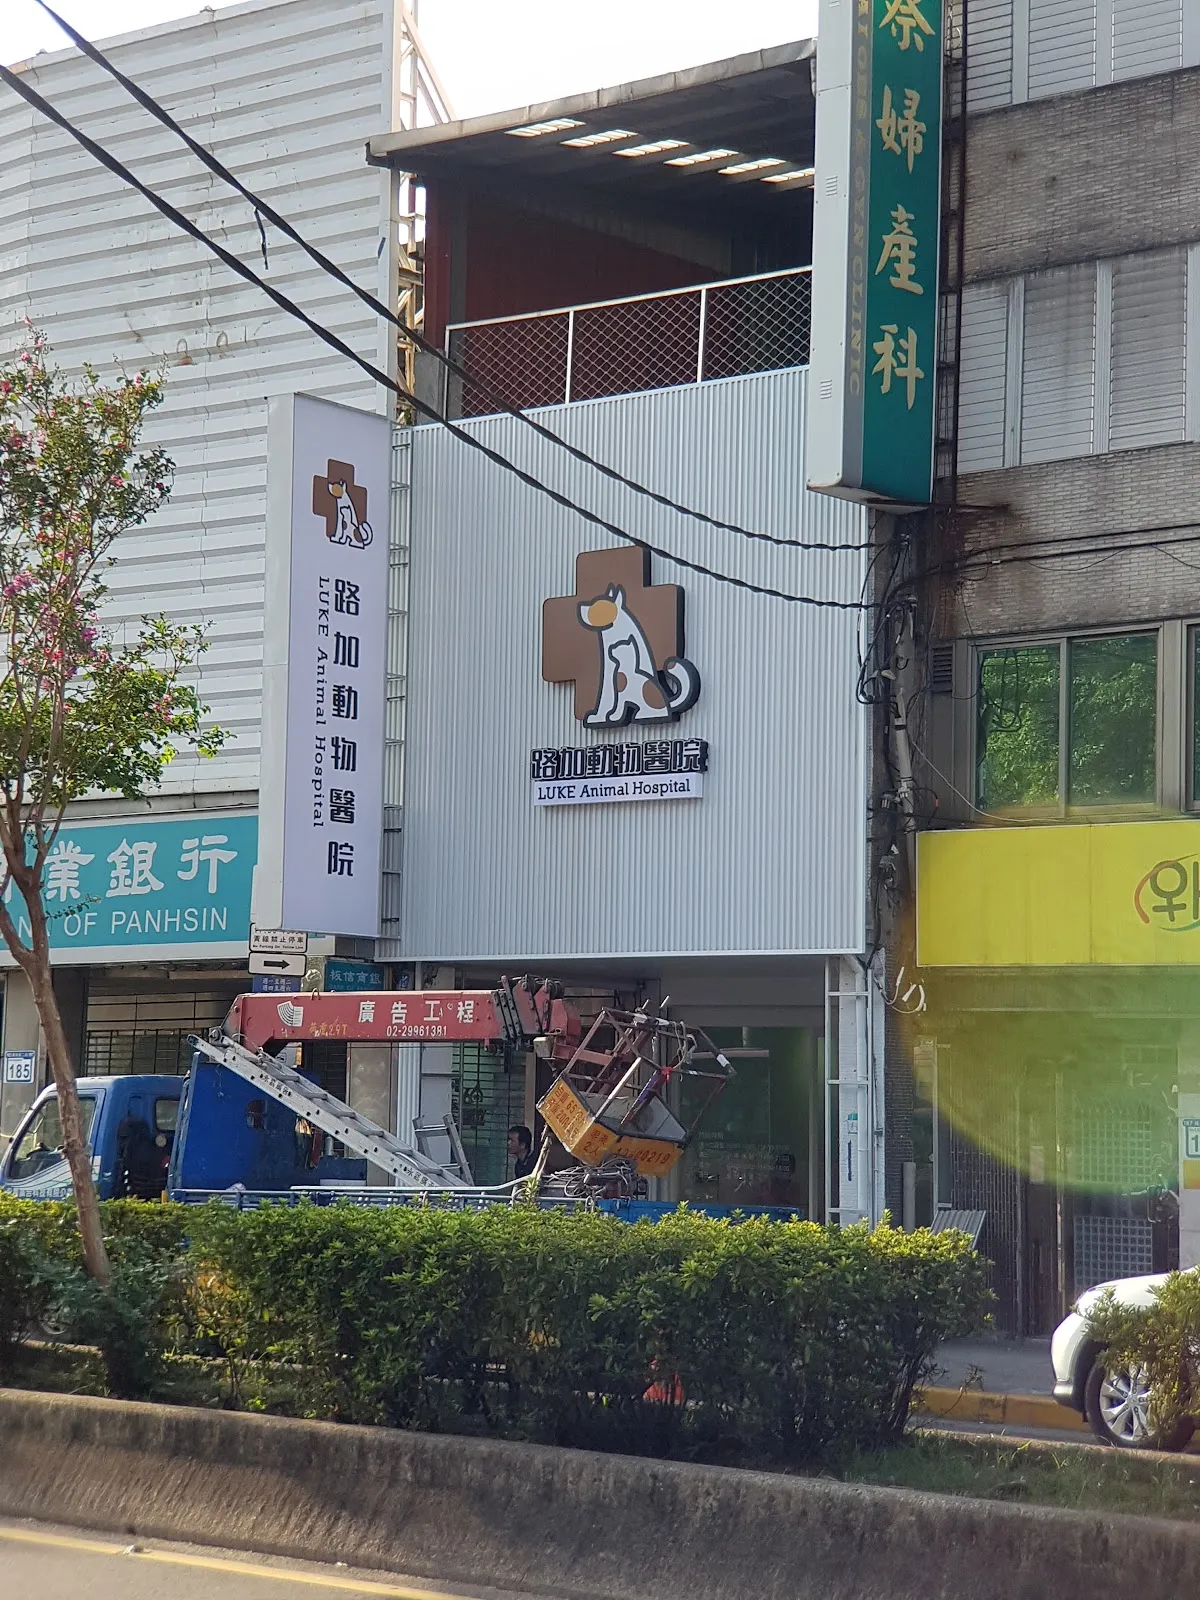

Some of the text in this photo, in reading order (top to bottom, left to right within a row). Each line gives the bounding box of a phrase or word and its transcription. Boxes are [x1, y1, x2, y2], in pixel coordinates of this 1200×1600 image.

[849, 254, 864, 396] CLINIC
[311, 575, 330, 828] LUKE Animal Hospital
[327, 578, 361, 877] 路加動物醫院
[531, 738, 708, 781] 路加動物醫院
[537, 778, 691, 801] LUKE Animal Hospital
[0, 835, 238, 904] 業銀行
[63, 912, 98, 937] OF
[110, 907, 228, 935] PANHSIN
[358, 1000, 475, 1024] 廣告工程
[386, 1025, 447, 1037] 02-29961381
[9, 1063, 30, 1078] 185
